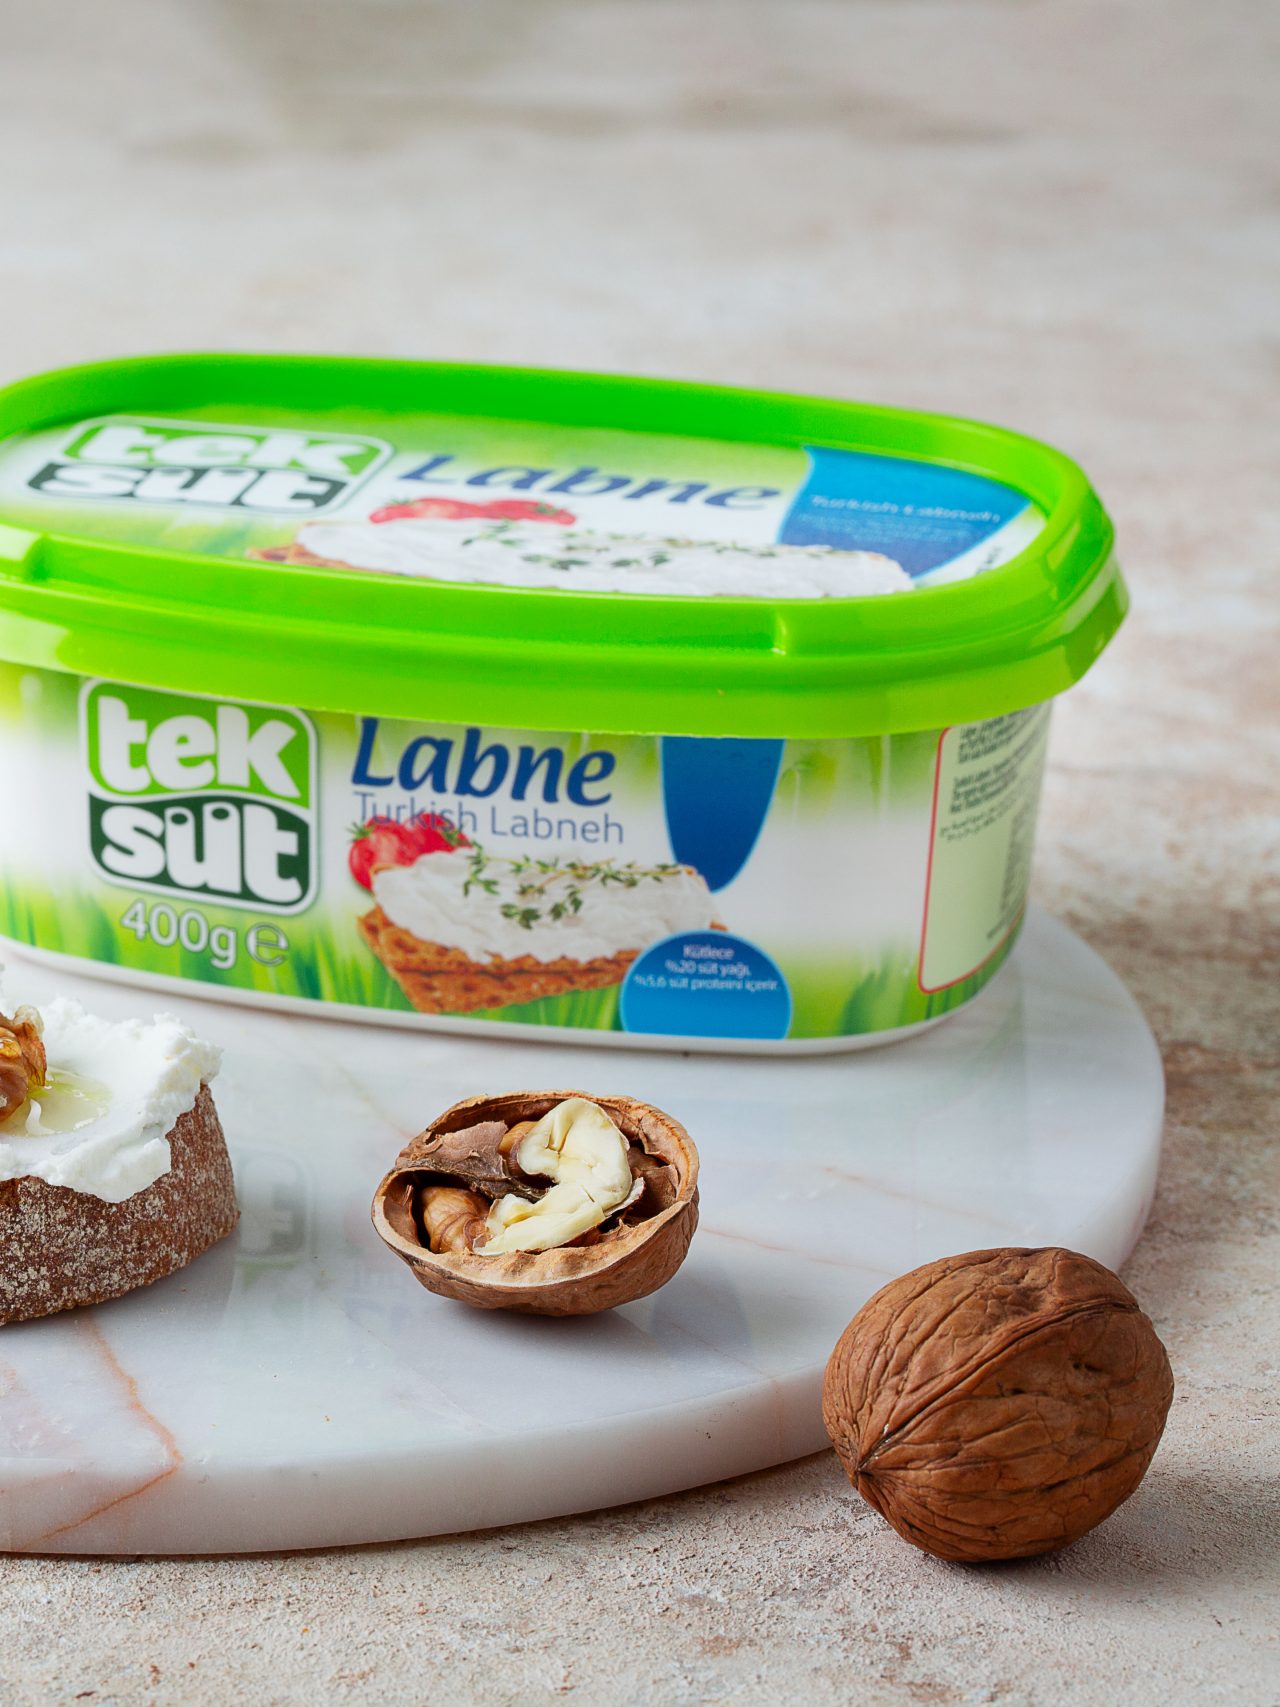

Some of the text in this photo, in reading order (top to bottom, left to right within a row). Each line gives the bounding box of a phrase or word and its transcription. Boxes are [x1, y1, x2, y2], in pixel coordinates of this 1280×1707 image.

[77, 424, 368, 475] tek
[397, 454, 781, 510] Labne
[97, 694, 301, 799] tek
[350, 716, 616, 807] Labne
[100, 801, 303, 904] süt
[353, 791, 624, 844] Turkish Labneh
[121, 898, 238, 970] 400g
